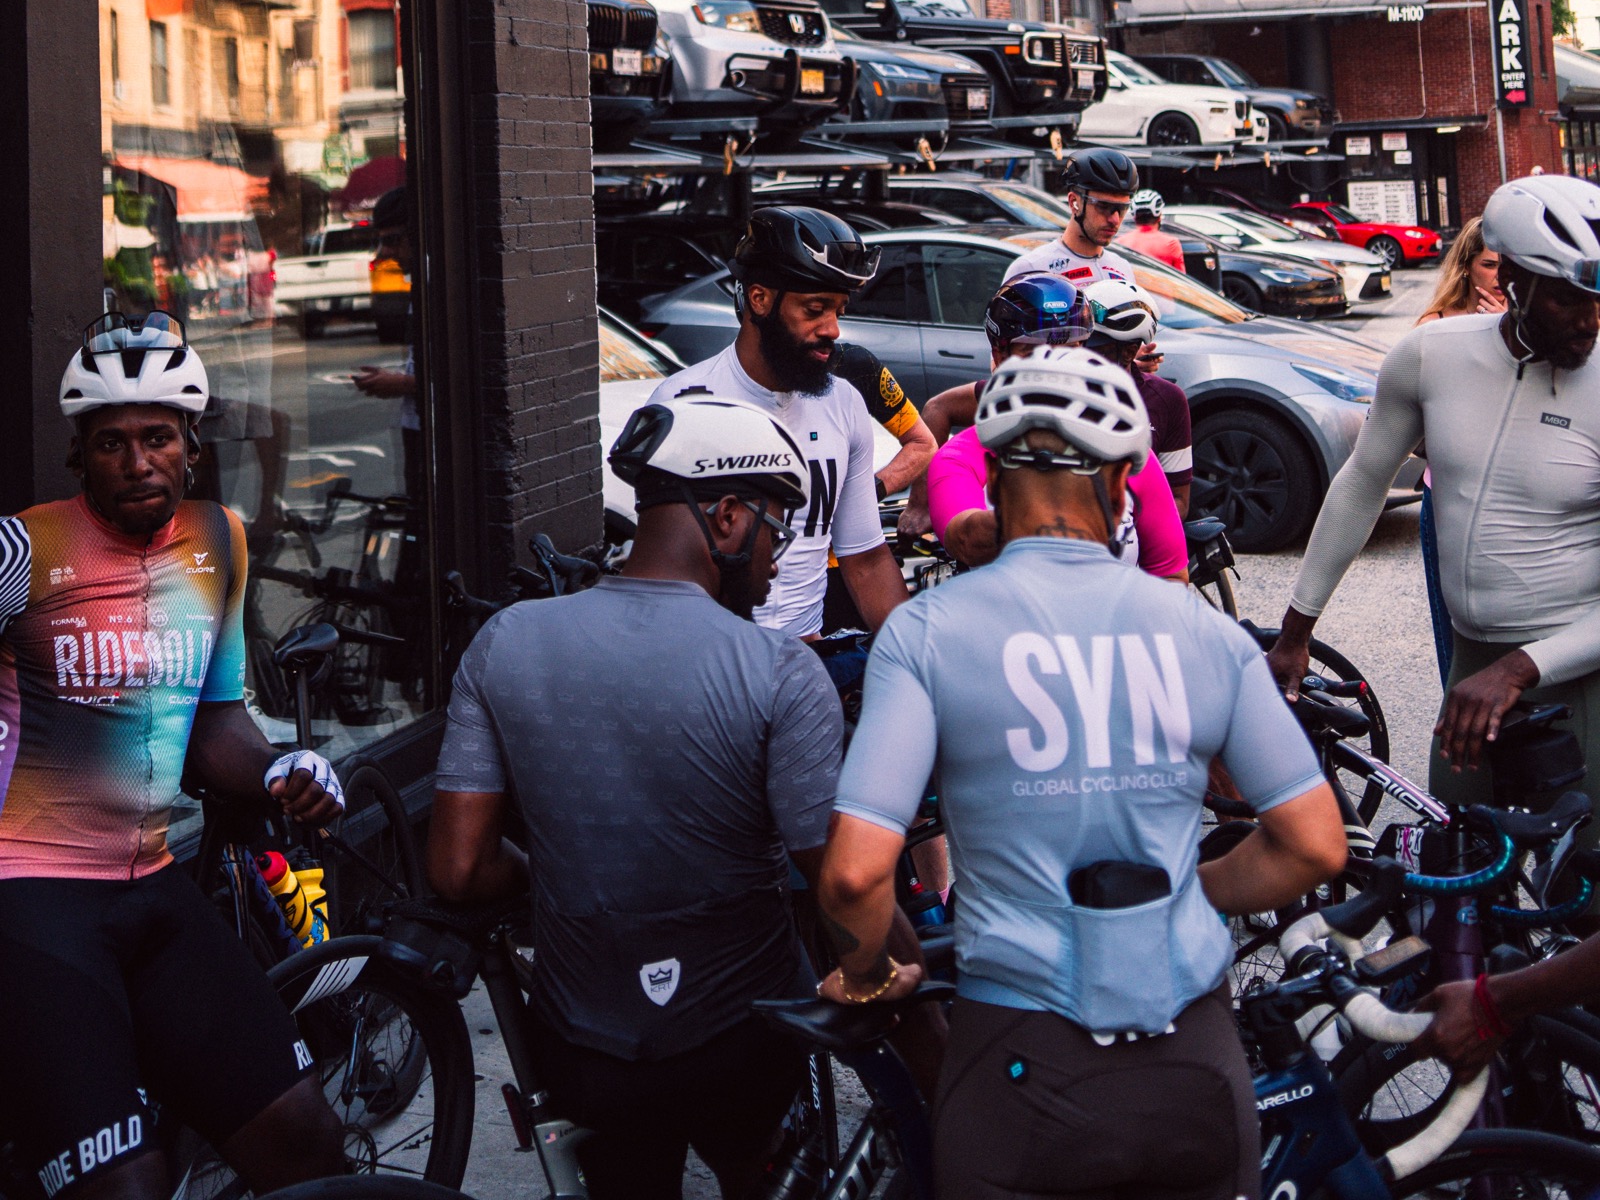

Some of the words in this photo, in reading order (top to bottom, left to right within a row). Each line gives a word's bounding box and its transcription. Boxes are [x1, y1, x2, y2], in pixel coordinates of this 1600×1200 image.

[1501, 71, 1525, 82] ENTER
[1504, 81, 1524, 90] HERE
[691, 453, 792, 475] S-WORKS
[1003, 632, 1192, 773] SYN
[1012, 779, 1079, 797] GLOBAL
[1081, 774, 1148, 794] CYCLING
[1151, 772, 1188, 789] CLUB
[38, 1150, 75, 1199] RIDE
[78, 1114, 142, 1174] BOLD
